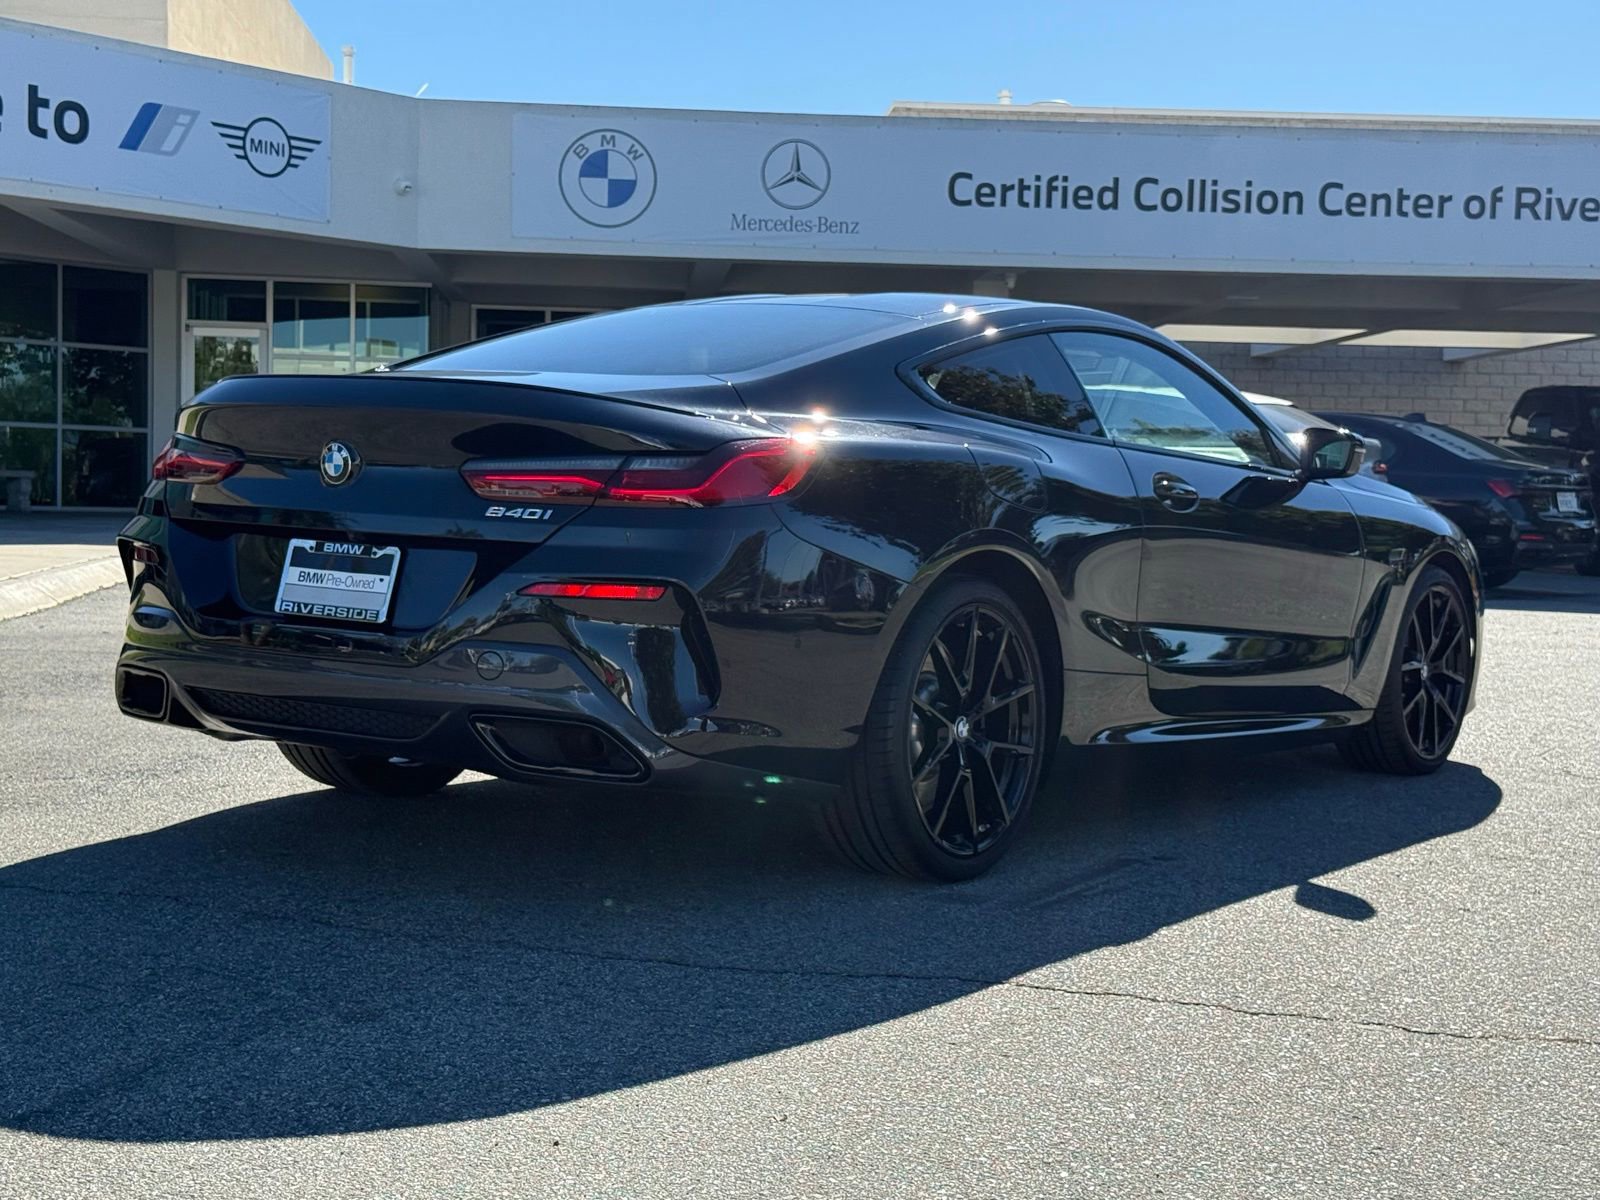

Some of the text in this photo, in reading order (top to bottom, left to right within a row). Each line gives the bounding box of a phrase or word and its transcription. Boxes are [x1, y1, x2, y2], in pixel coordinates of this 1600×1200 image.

[27, 83, 90, 144] to
[249, 137, 286, 159] MINI
[573, 134, 644, 161] BMW
[947, 171, 1600, 222] Certified Collision Center of Rive
[730, 212, 860, 235] Mercedes-Benz
[323, 542, 365, 555] BMW
[297, 570, 376, 590] BMW Pre-Owned
[281, 602, 379, 620] RIVERSIDE
